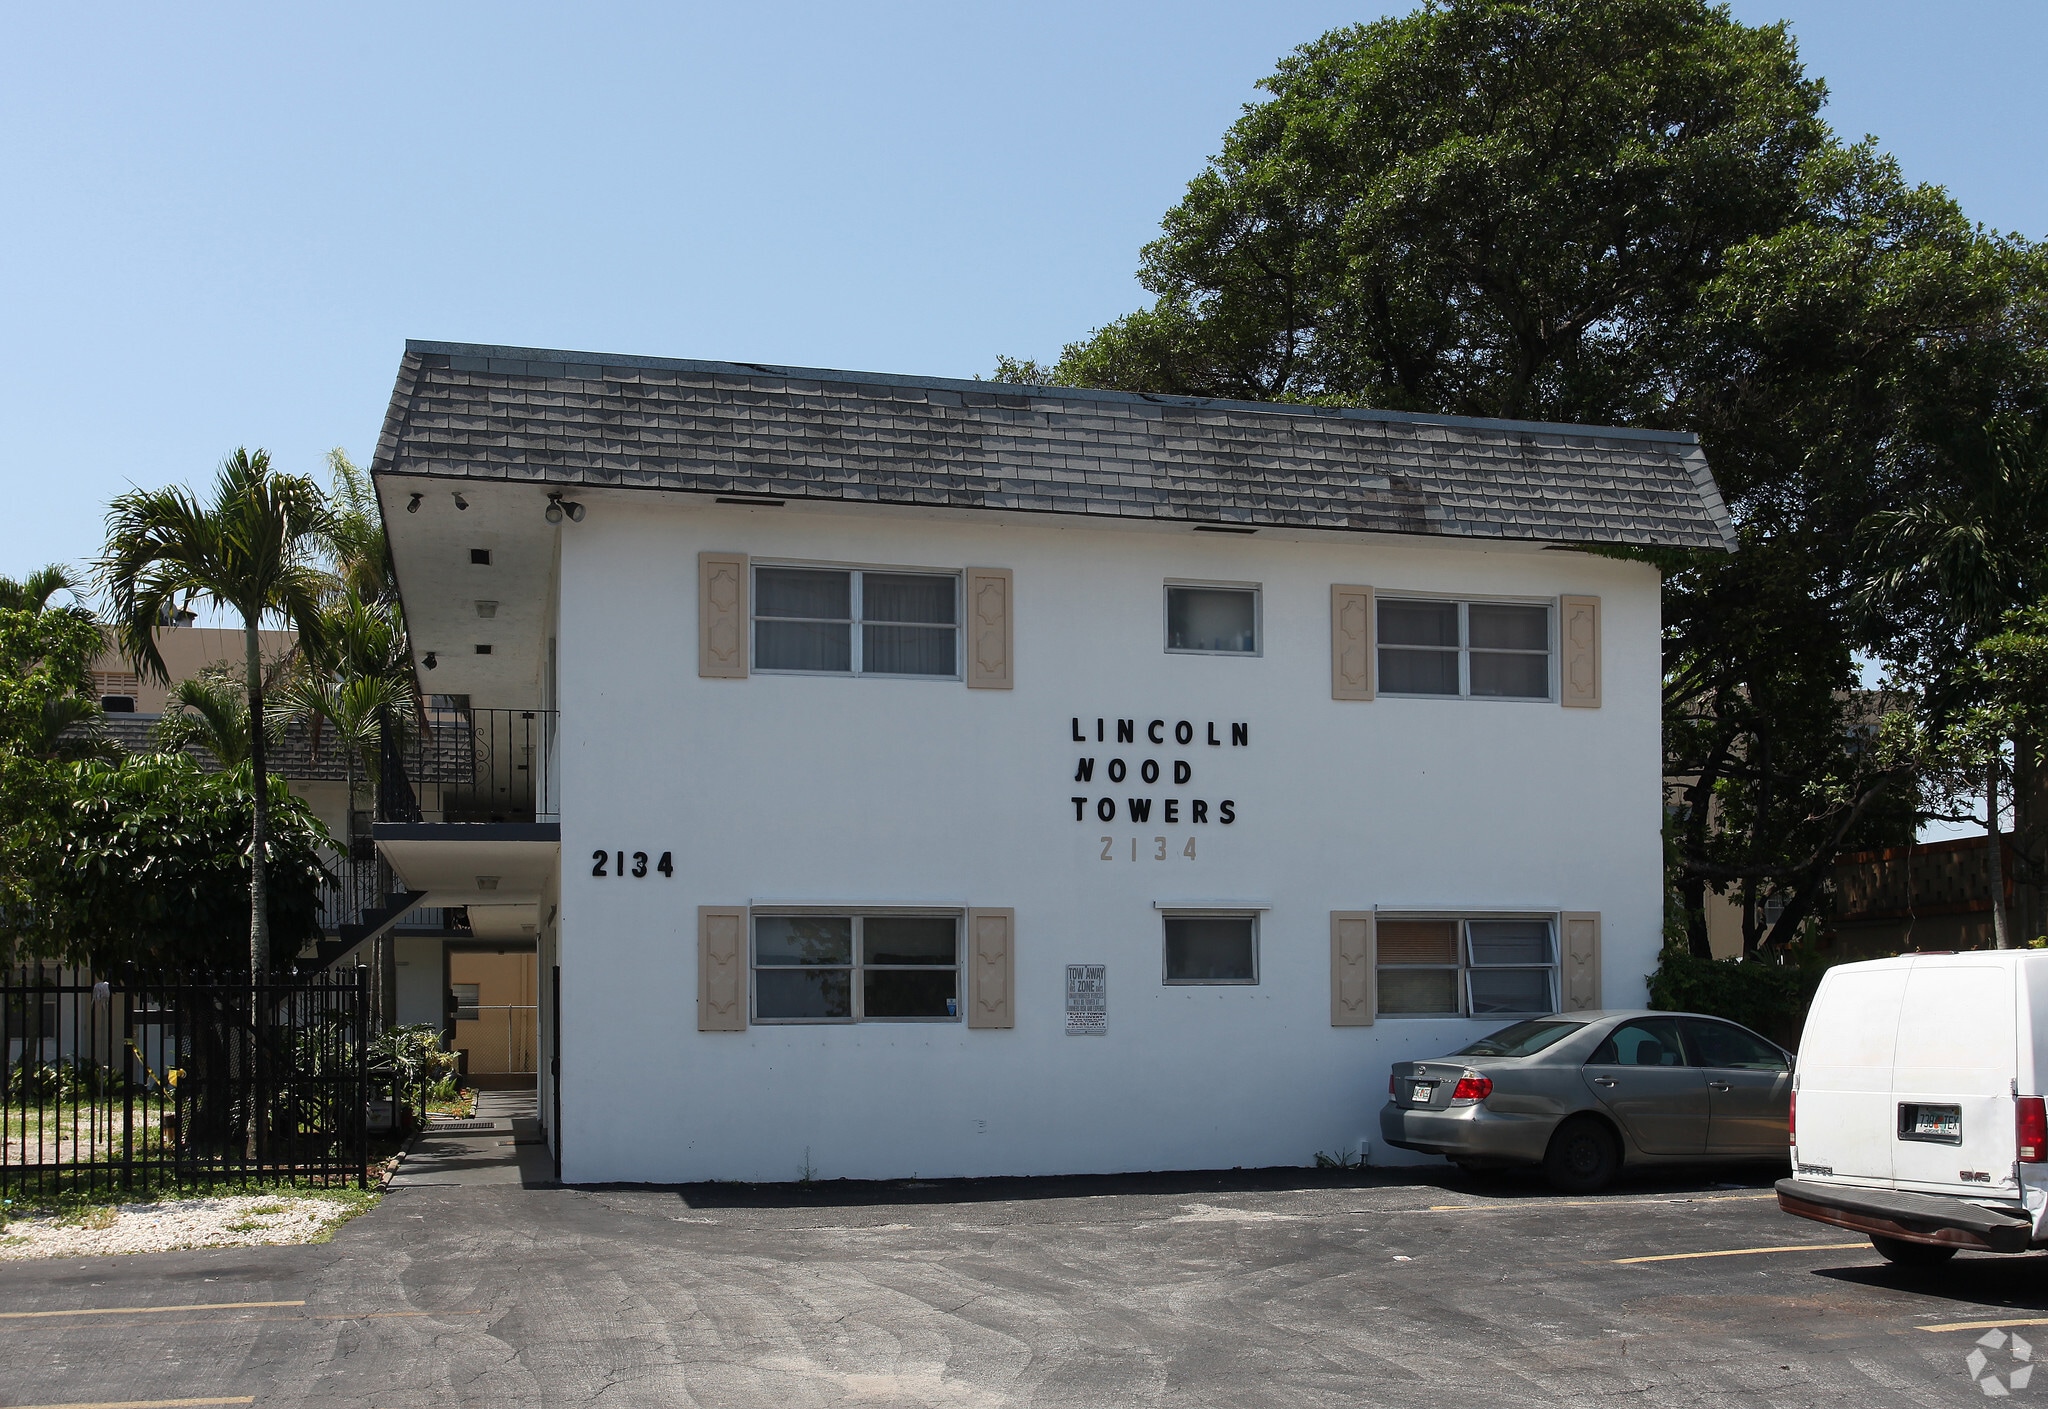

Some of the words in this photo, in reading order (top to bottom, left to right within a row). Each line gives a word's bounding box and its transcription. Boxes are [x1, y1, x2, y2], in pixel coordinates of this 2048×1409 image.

[1072, 717, 1248, 746] LINCOLN
[1071, 797, 1236, 825] TOWERS
[1100, 836, 1197, 862] 2134
[592, 850, 674, 878] 2134
[1068, 968, 1084, 979] TOW
[1086, 968, 1104, 979] AWAY
[1078, 981, 1094, 992] ZONE
